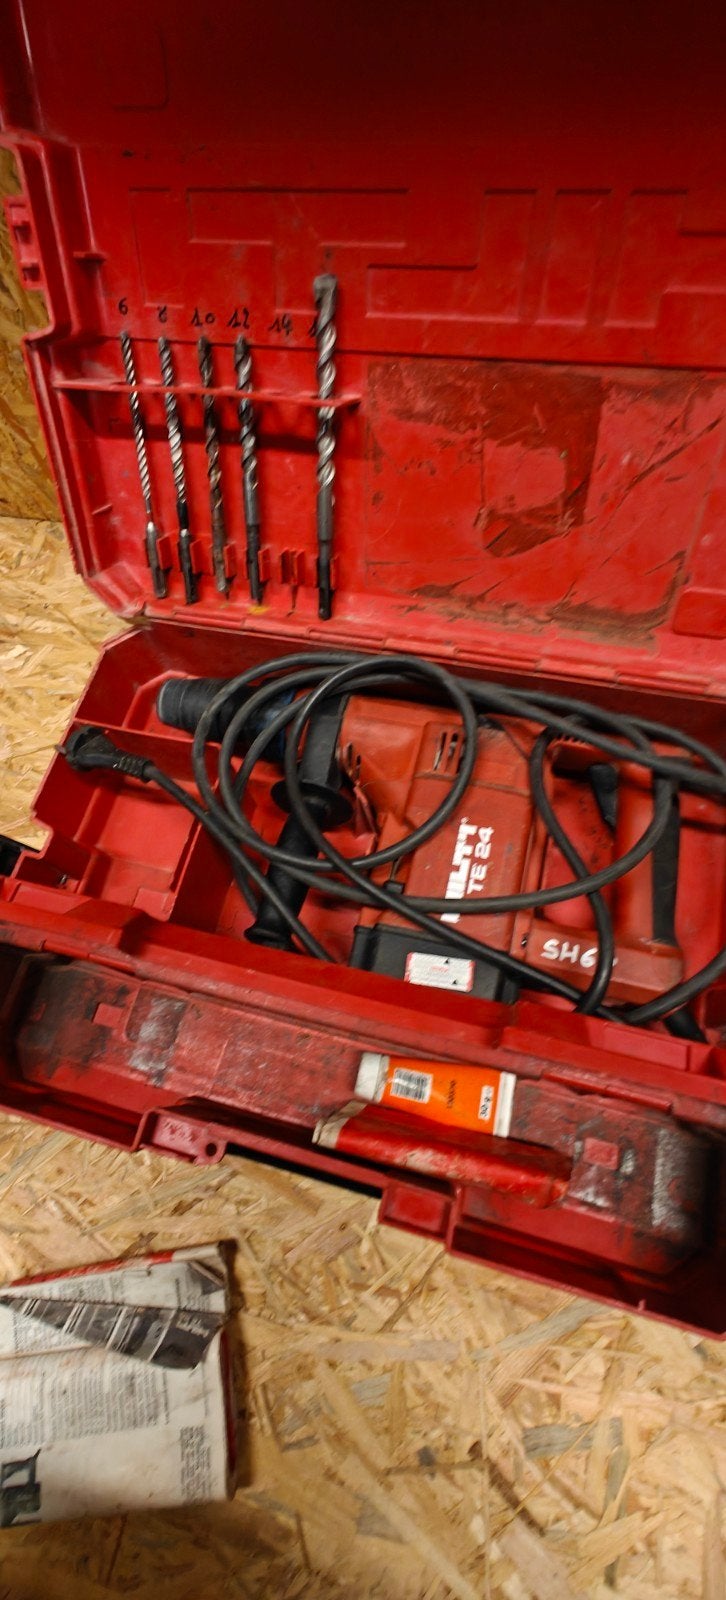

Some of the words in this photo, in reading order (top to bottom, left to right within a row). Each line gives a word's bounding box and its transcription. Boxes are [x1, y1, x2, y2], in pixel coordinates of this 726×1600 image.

[118, 298, 128, 315] 6
[191, 308, 216, 327] 10
[226, 308, 251, 328] 12
[268, 313, 293, 337] 14
[474, 826, 495, 859] 24
[467, 862, 488, 895] TE
[541, 938, 619, 968] SH6
